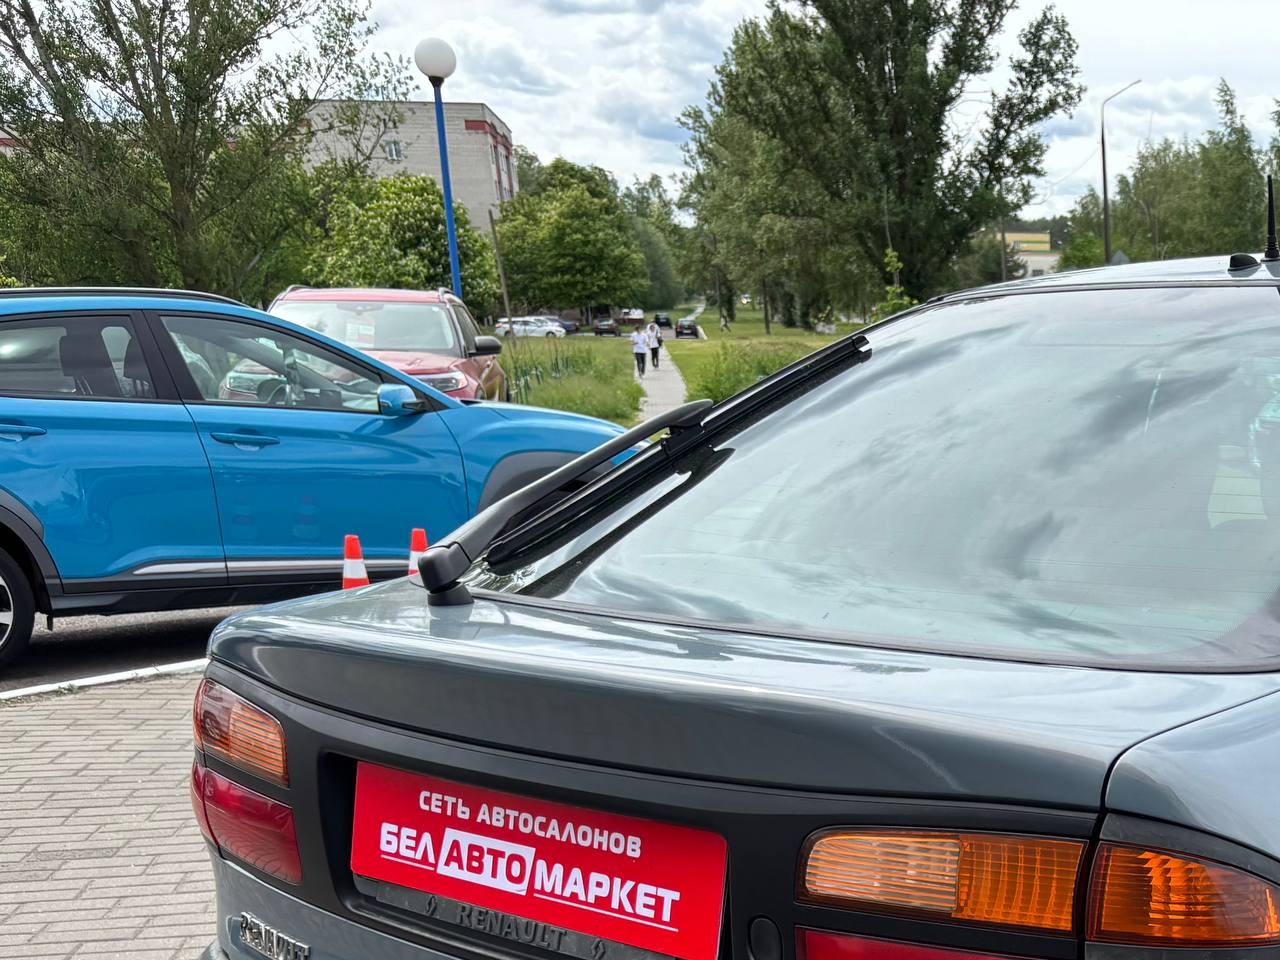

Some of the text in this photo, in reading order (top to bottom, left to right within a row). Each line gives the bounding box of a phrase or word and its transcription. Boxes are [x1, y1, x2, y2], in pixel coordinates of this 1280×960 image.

[419, 790, 642, 858] СЕТЬ АВТОСАЛОНОВ
[456, 904, 568, 951] RENAULT
